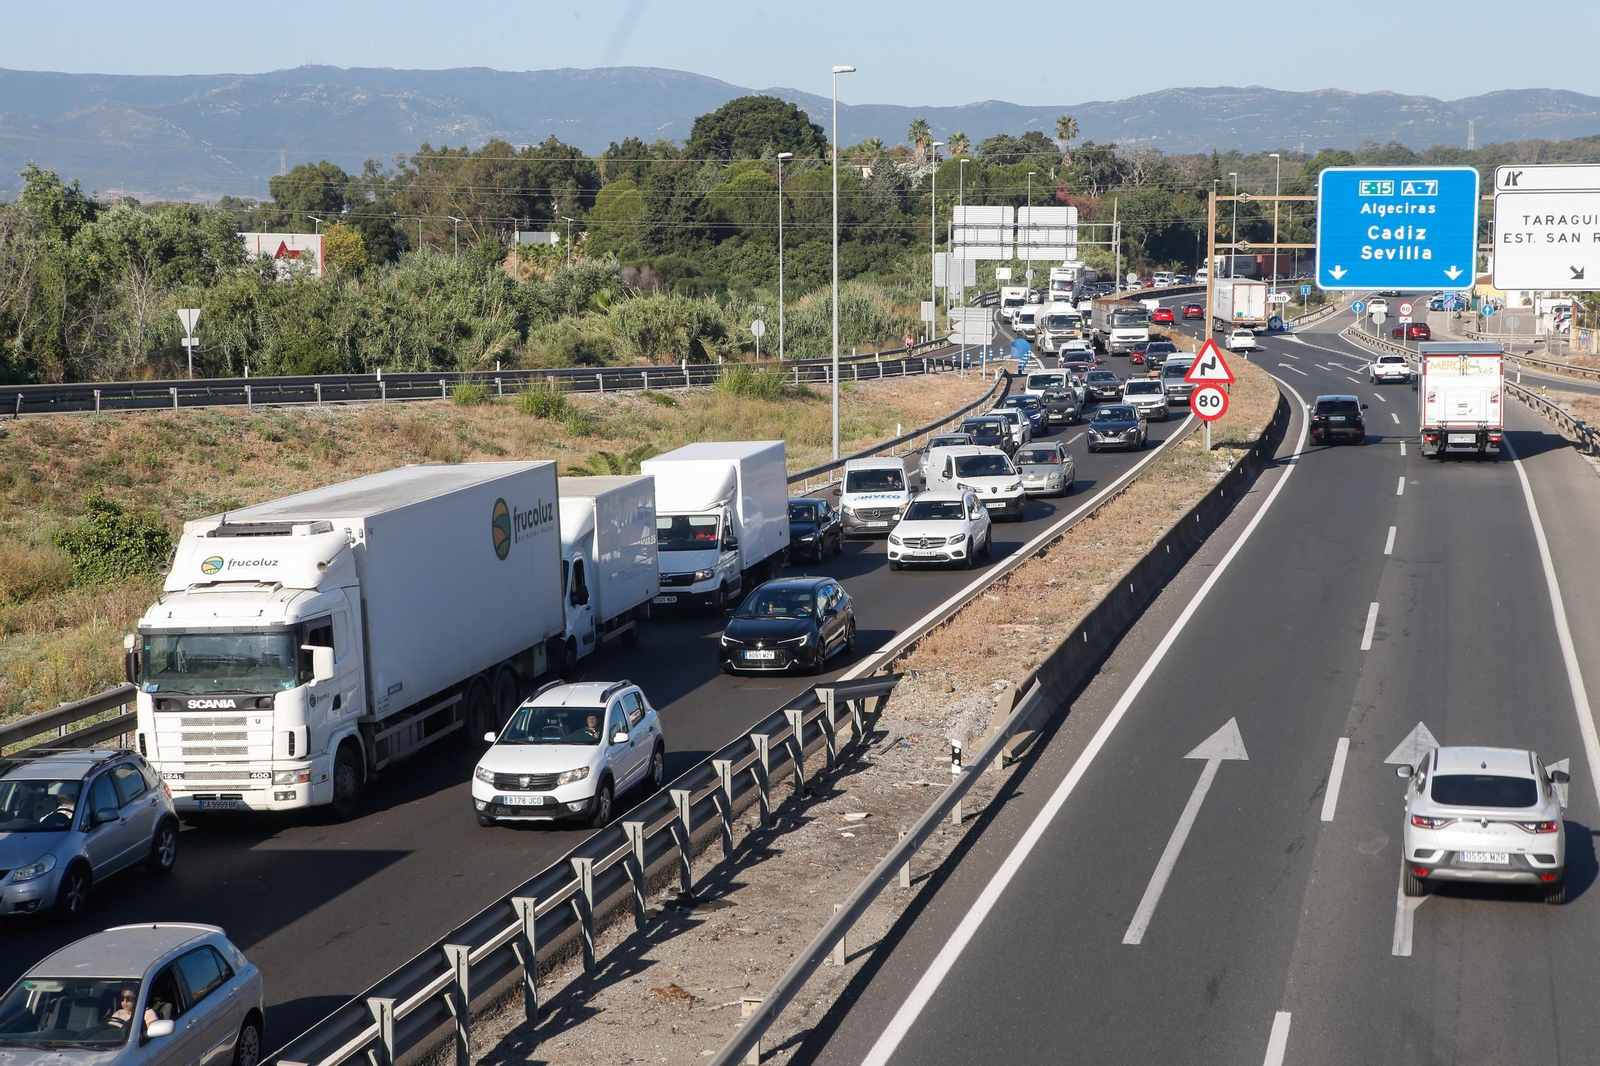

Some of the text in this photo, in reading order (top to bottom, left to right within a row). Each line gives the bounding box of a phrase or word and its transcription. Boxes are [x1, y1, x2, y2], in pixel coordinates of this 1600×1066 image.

[1361, 182, 1392, 194] E-15
[1360, 202, 1436, 217] Algeciras
[1522, 214, 1598, 226] TARAGUI
[1367, 225, 1426, 240] Cadiz
[1503, 232, 1536, 244] EST.
[1546, 231, 1581, 243] SAN
[1360, 245, 1432, 260] Sevilla
[1199, 394, 1220, 408] 80
[513, 498, 554, 544] frucoluz
[227, 557, 279, 571] frucoluz
[187, 699, 236, 709] SCANIA
[203, 801, 237, 809] CA 9999 BK
[508, 796, 542, 805] 8178 JCD
[1466, 851, 1506, 861] 0555 MZR
